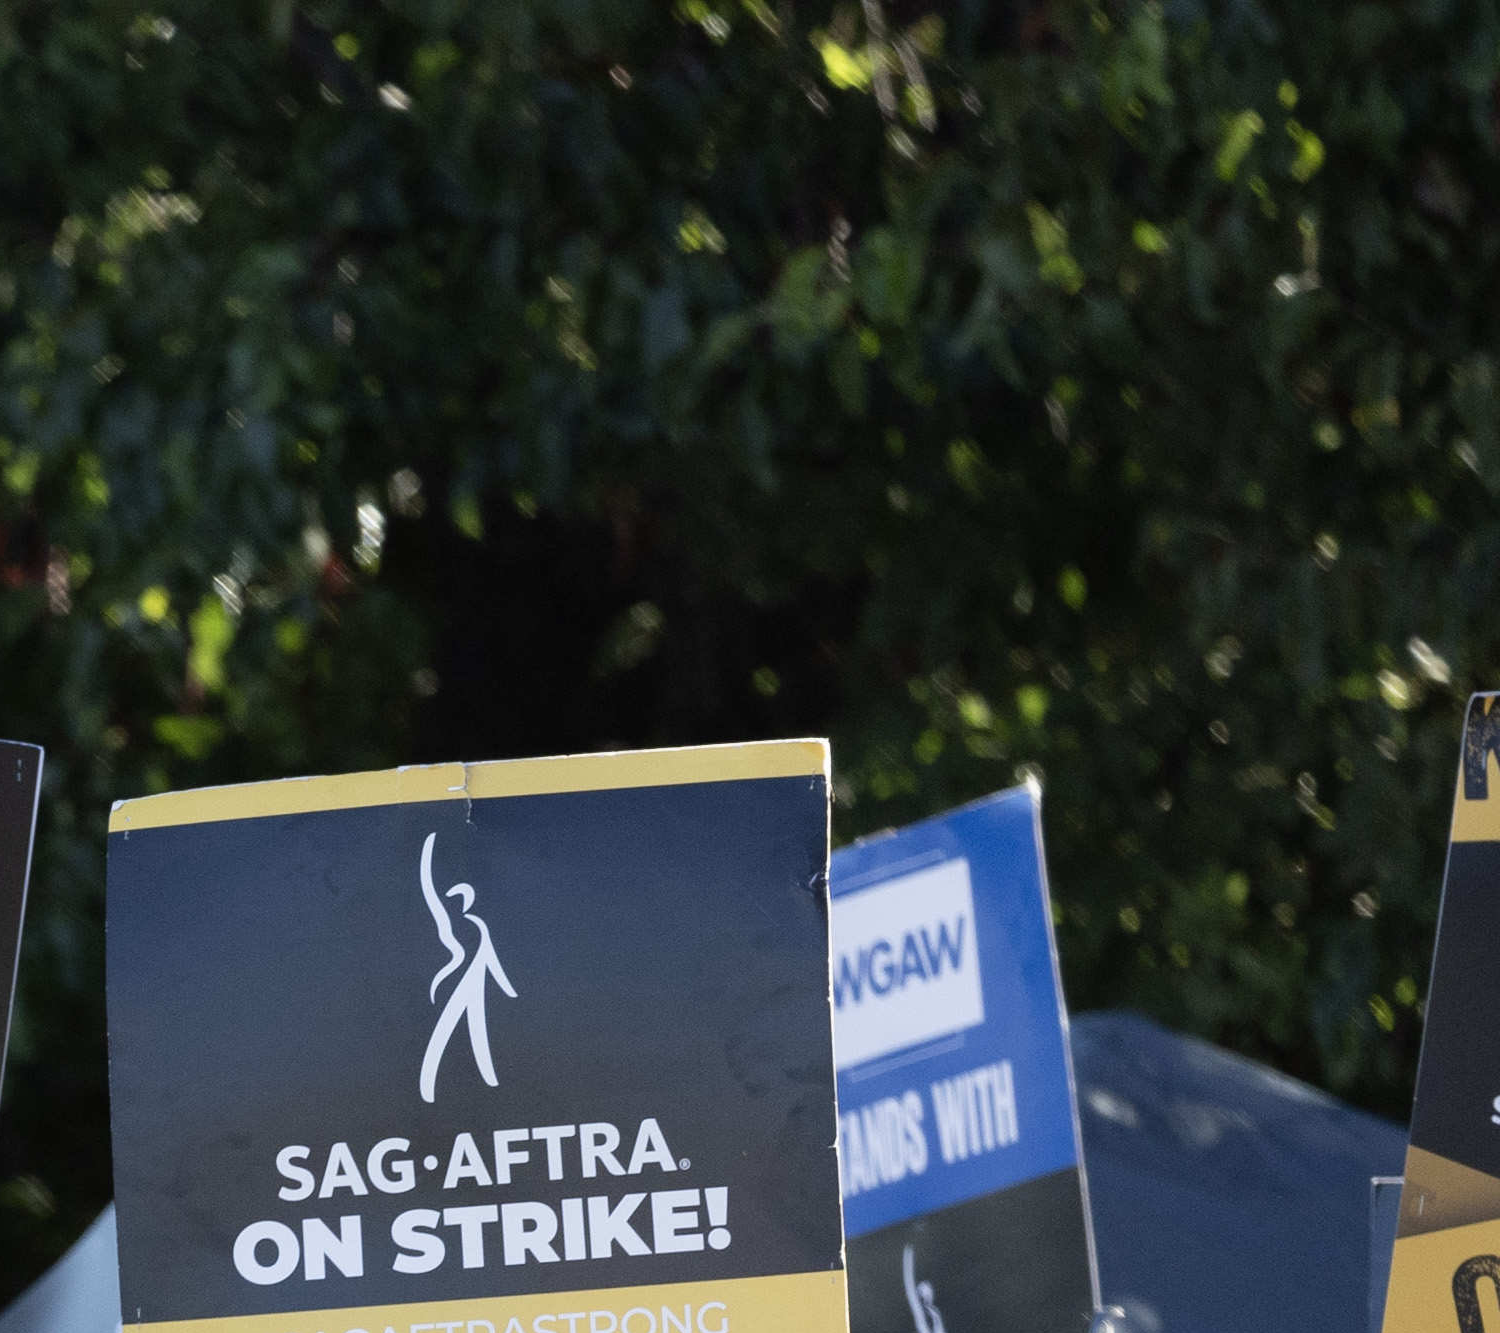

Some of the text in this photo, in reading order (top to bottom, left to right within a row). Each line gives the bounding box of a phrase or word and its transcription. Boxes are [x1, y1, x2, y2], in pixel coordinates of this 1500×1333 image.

[832, 915, 968, 1013] WGAW
[839, 1060, 1020, 1196] TANDS WITH
[233, 1186, 732, 1286] ON STRIKE!
